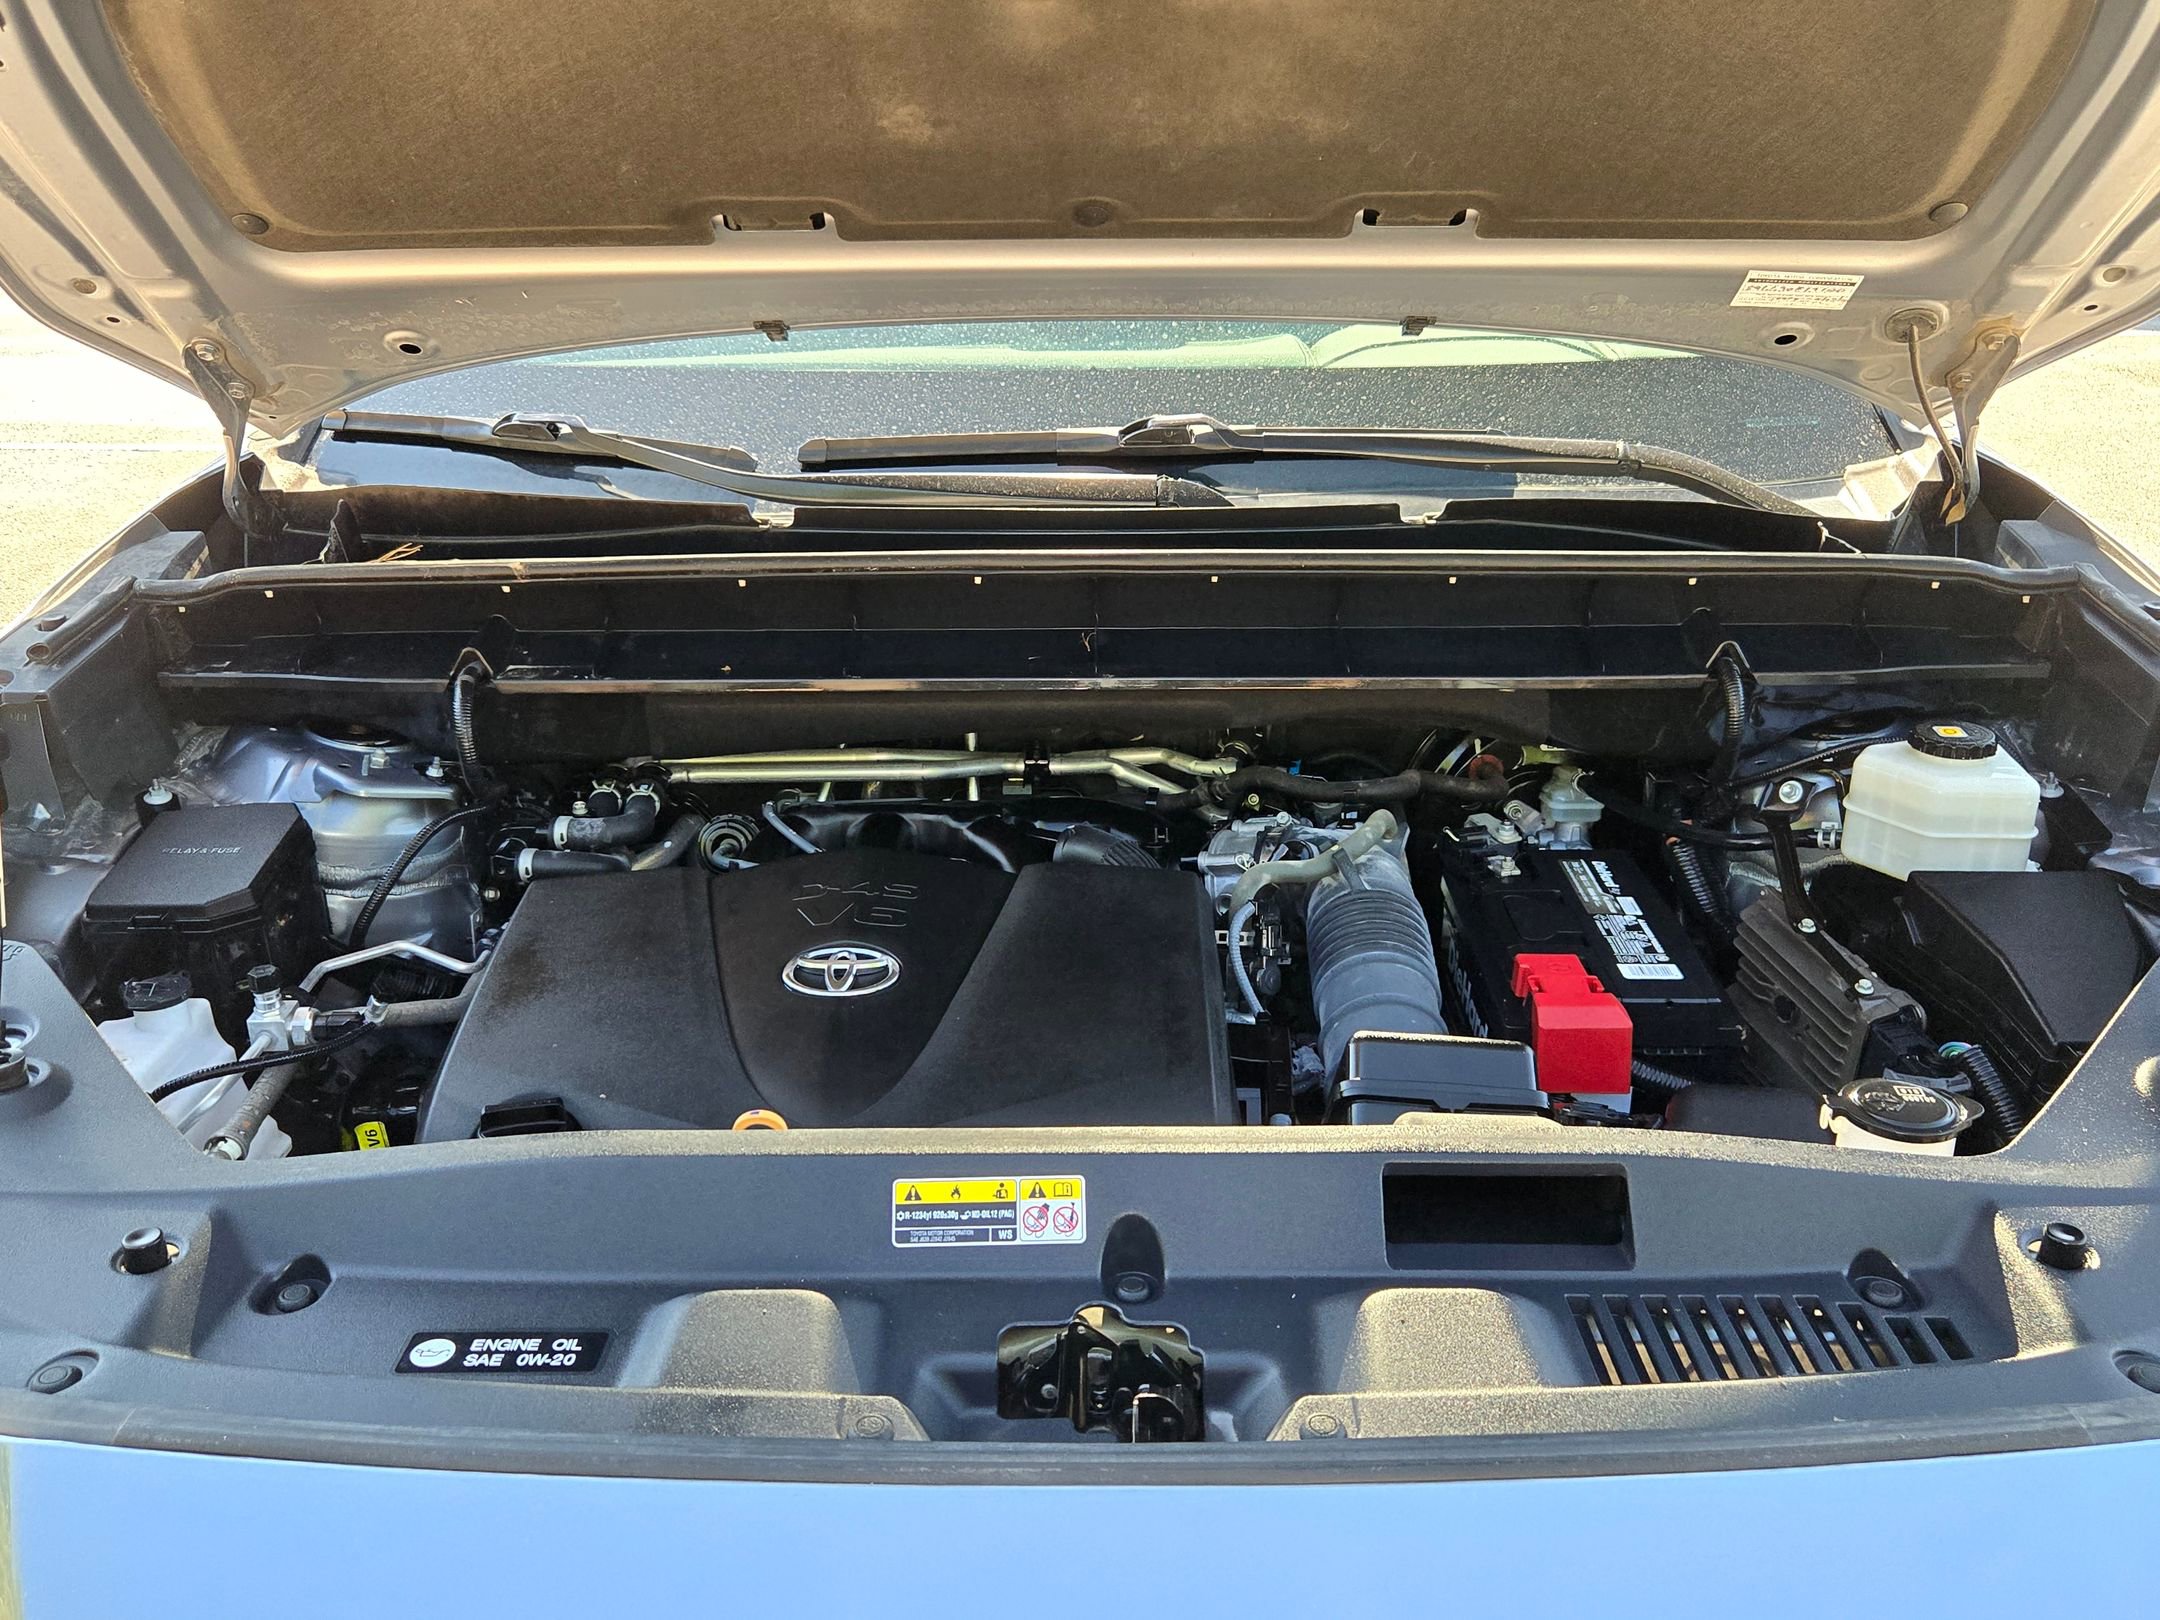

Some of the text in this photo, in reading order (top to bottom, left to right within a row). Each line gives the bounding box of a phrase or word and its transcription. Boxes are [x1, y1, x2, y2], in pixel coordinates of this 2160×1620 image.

[210, 846, 242, 854] FUSE
[364, 1129, 381, 1148] V6
[998, 1229, 1013, 1240] WS
[469, 1338, 583, 1351] ENGINE OIL
[463, 1353, 576, 1367] SAE 0W-20
